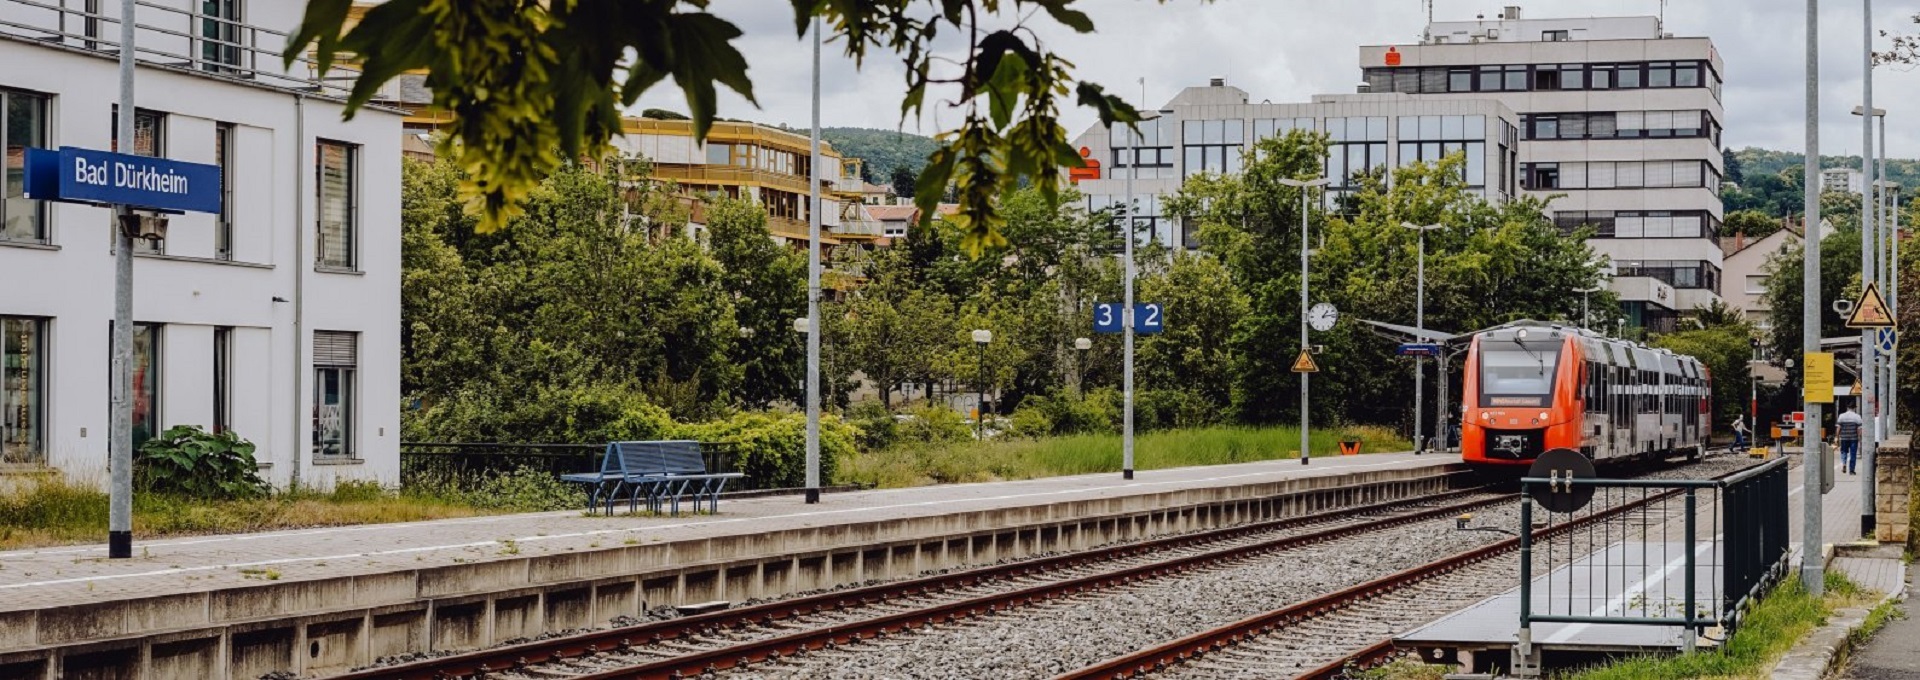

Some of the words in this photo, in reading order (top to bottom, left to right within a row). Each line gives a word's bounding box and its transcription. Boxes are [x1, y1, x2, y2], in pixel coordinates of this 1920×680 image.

[75, 156, 108, 186] Bad
[115, 162, 188, 194] Dürkheim
[1098, 303, 1112, 326] 3
[1144, 303, 1159, 326] 2
